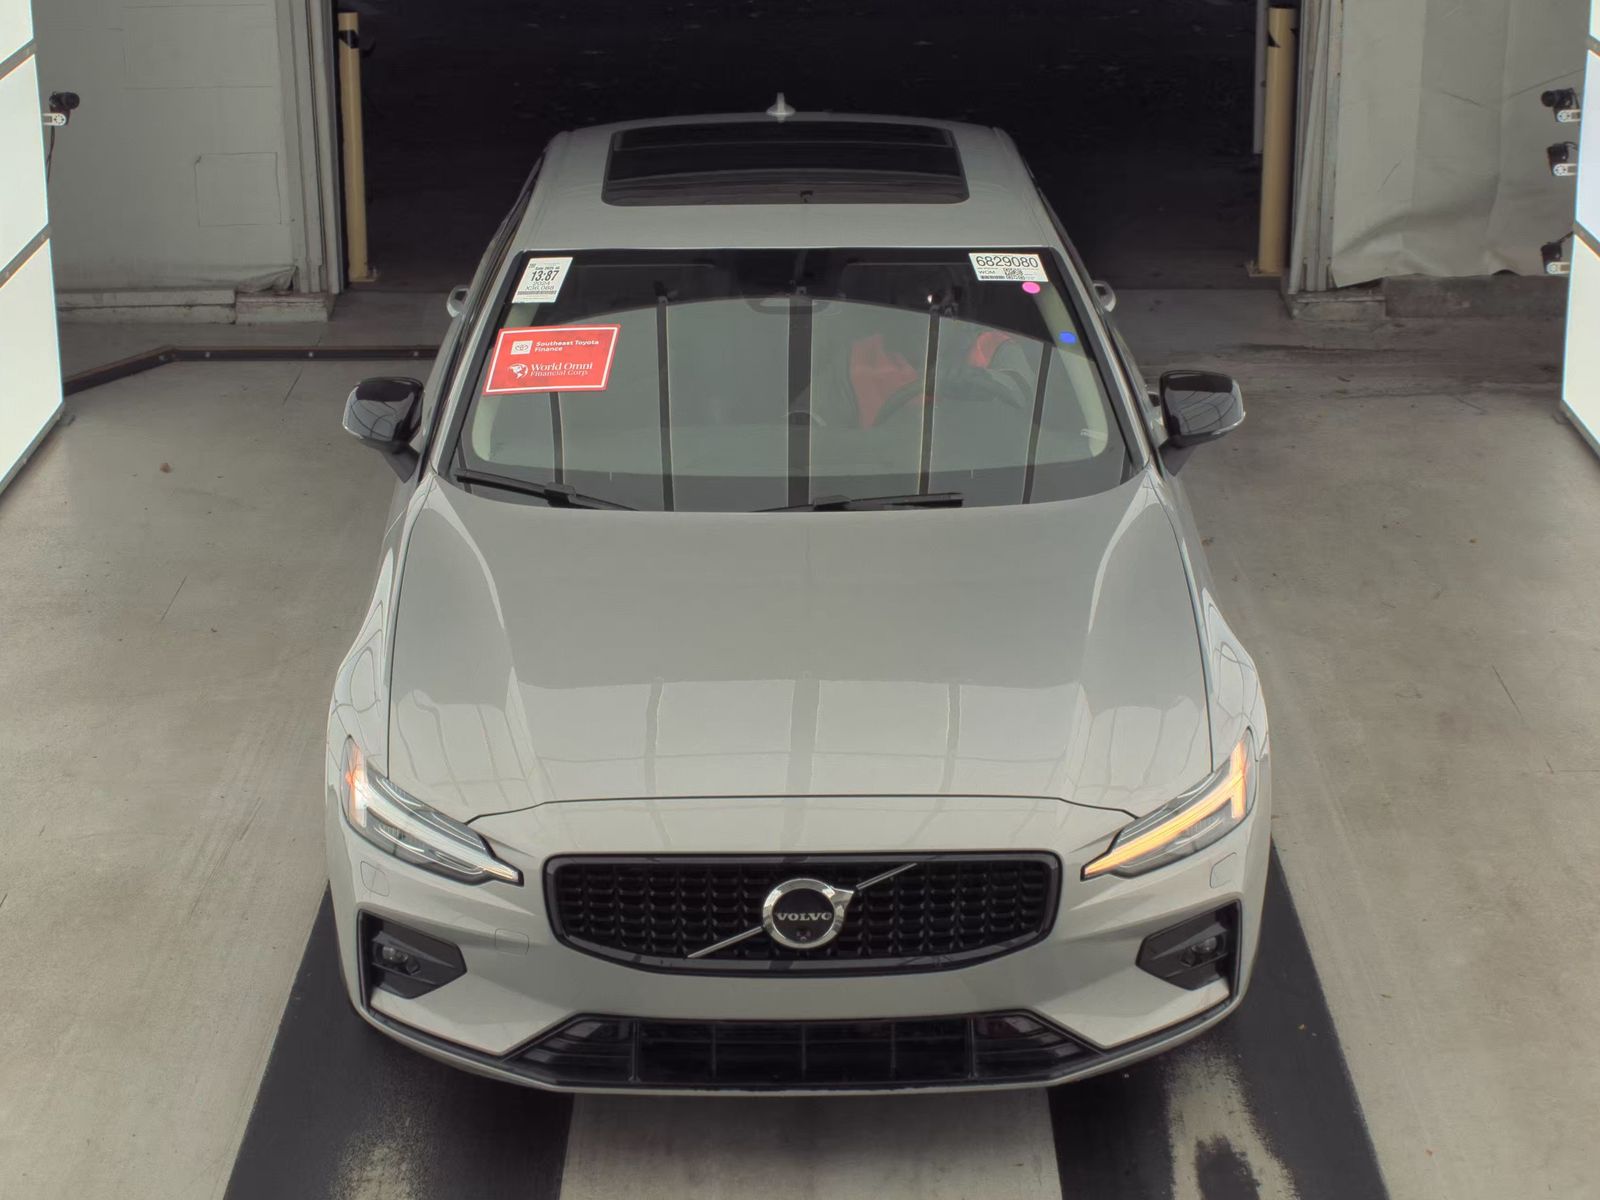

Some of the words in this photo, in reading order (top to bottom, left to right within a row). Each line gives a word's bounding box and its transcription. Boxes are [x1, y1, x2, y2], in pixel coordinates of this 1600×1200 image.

[976, 256, 1038, 267] 6829080
[531, 270, 559, 281] 13:87
[530, 362, 562, 370] World
[563, 361, 593, 370] Omni
[776, 912, 832, 921] VOLVO
